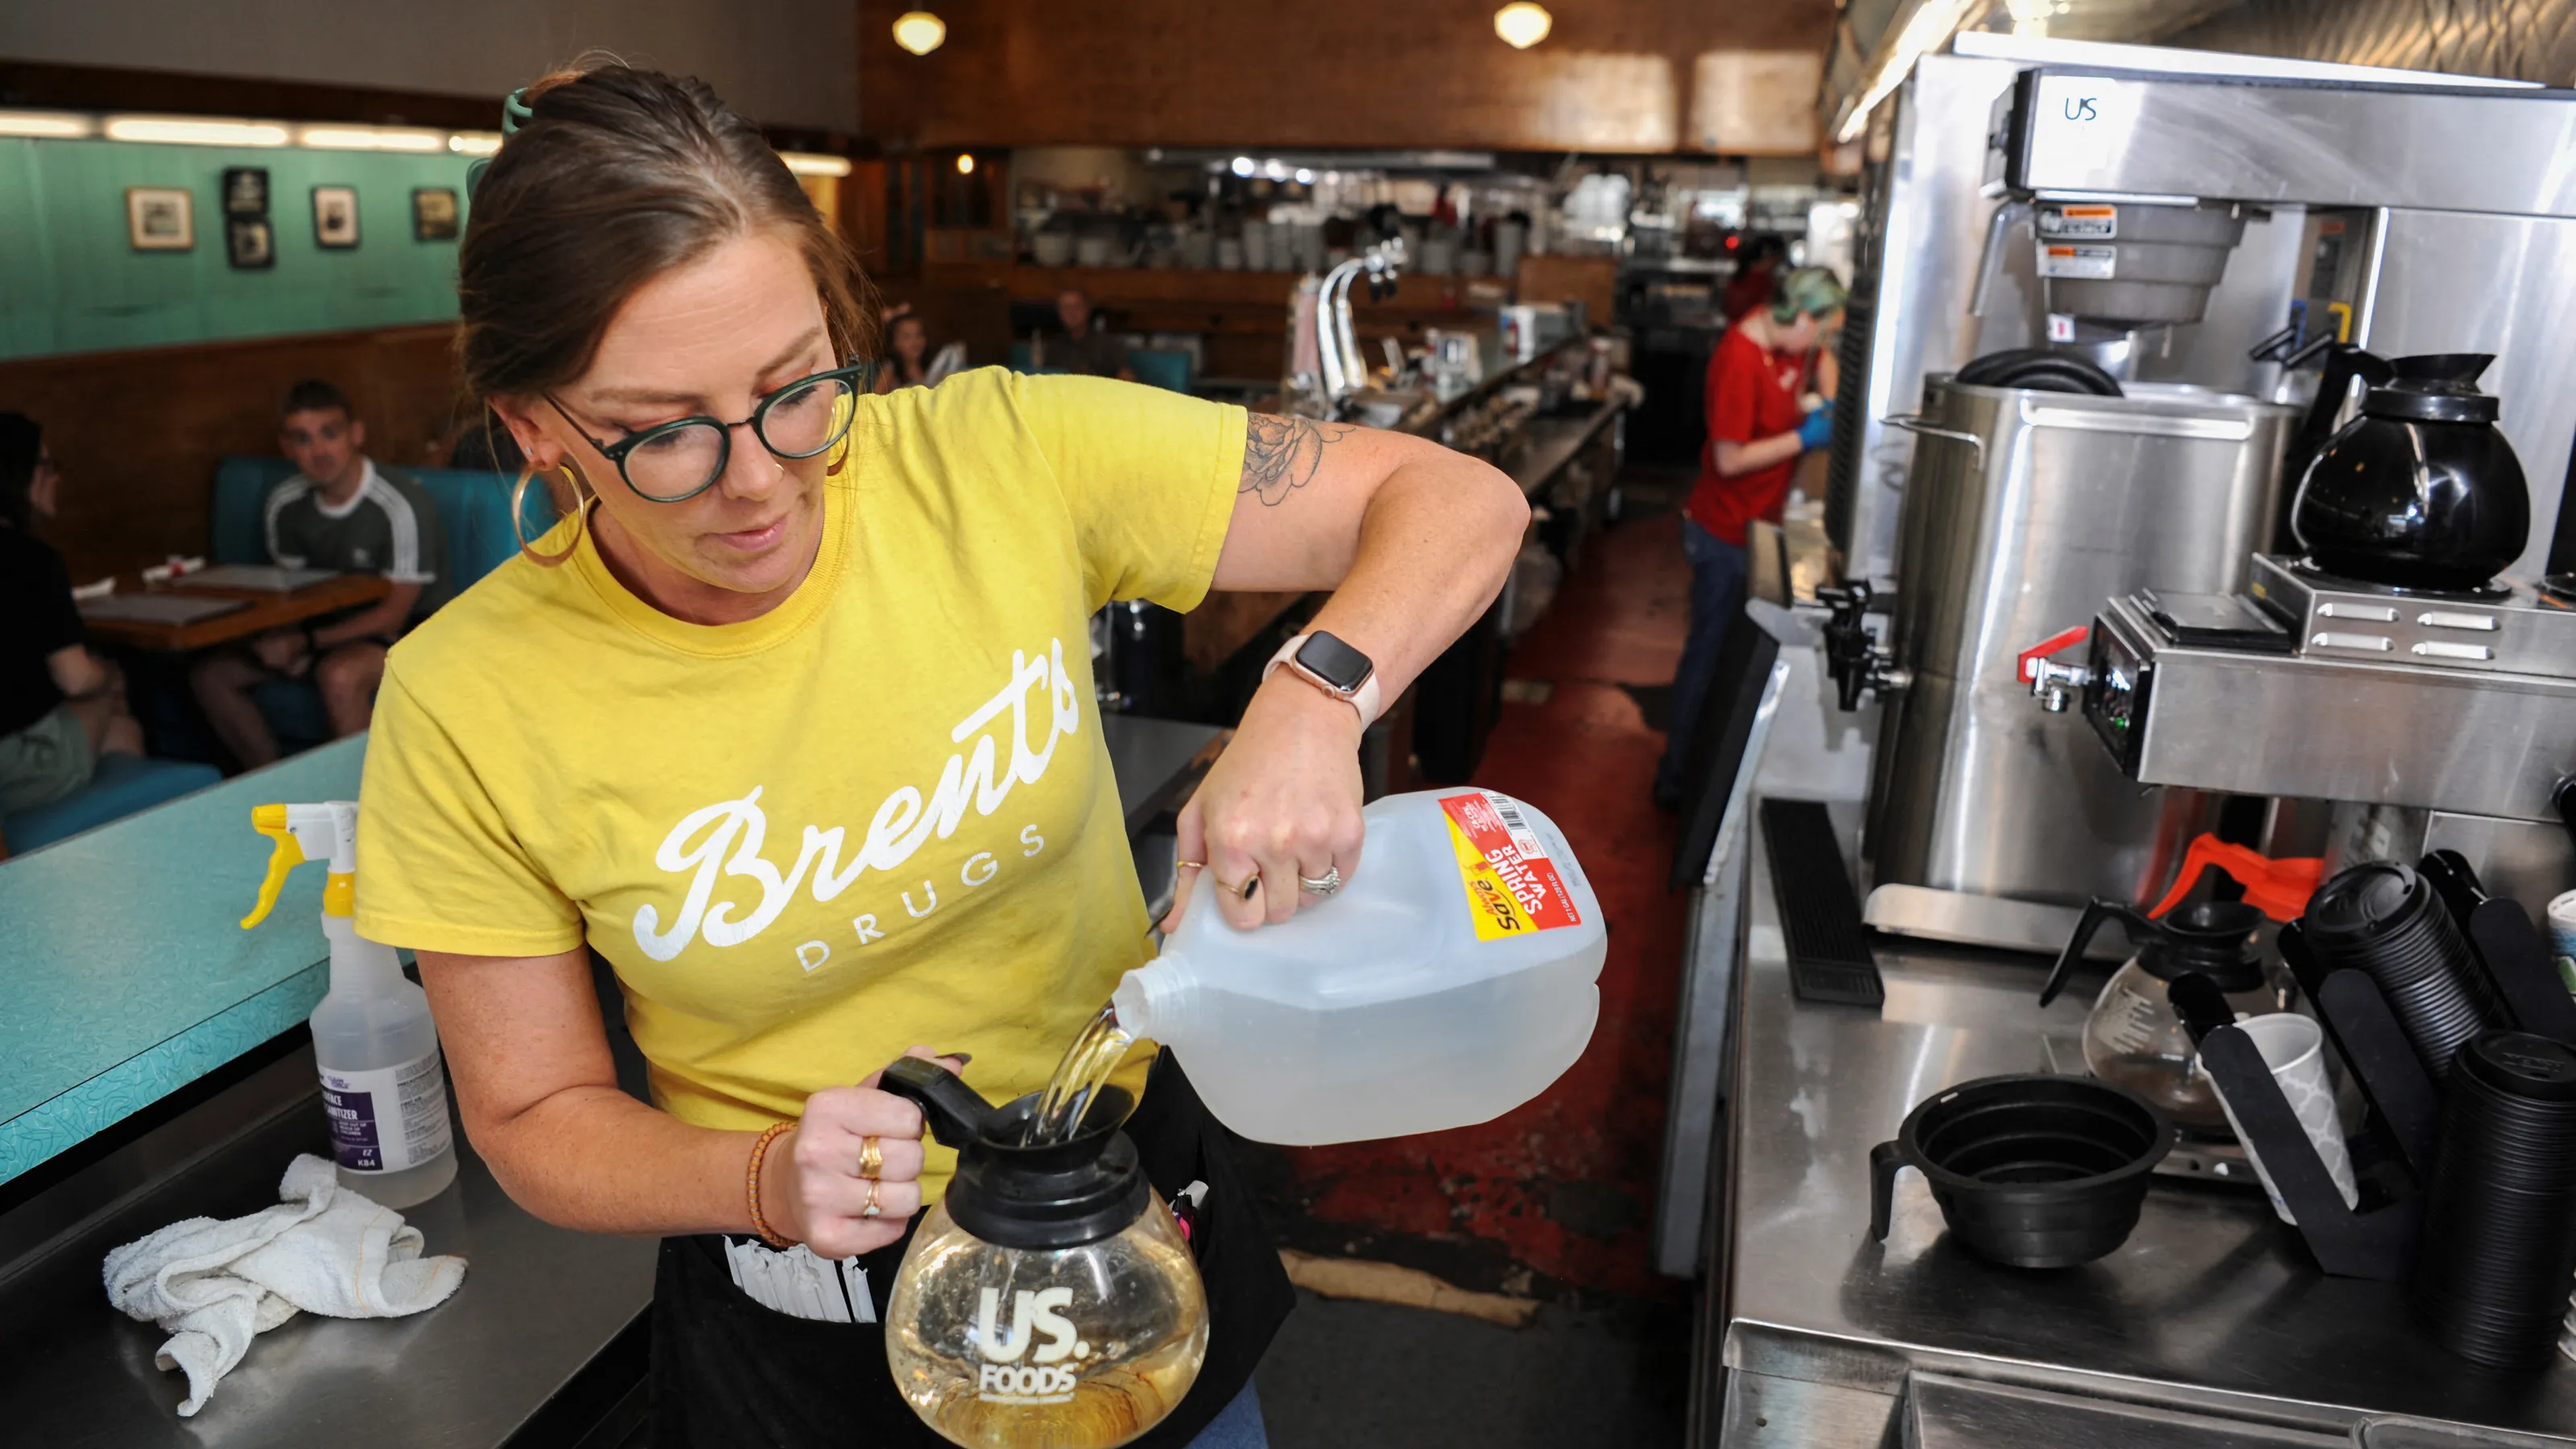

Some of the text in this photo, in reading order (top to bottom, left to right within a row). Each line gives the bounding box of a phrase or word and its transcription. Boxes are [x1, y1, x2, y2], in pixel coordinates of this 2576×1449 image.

[2065, 97, 2097, 121] US
[1484, 848, 1543, 914] SPRING
[1501, 844, 1546, 899] WATER
[795, 824, 1044, 972] DRUGS
[1468, 880, 1498, 916] Always
[1477, 880, 1521, 931] Save
[979, 1364, 1077, 1395] FOODS
